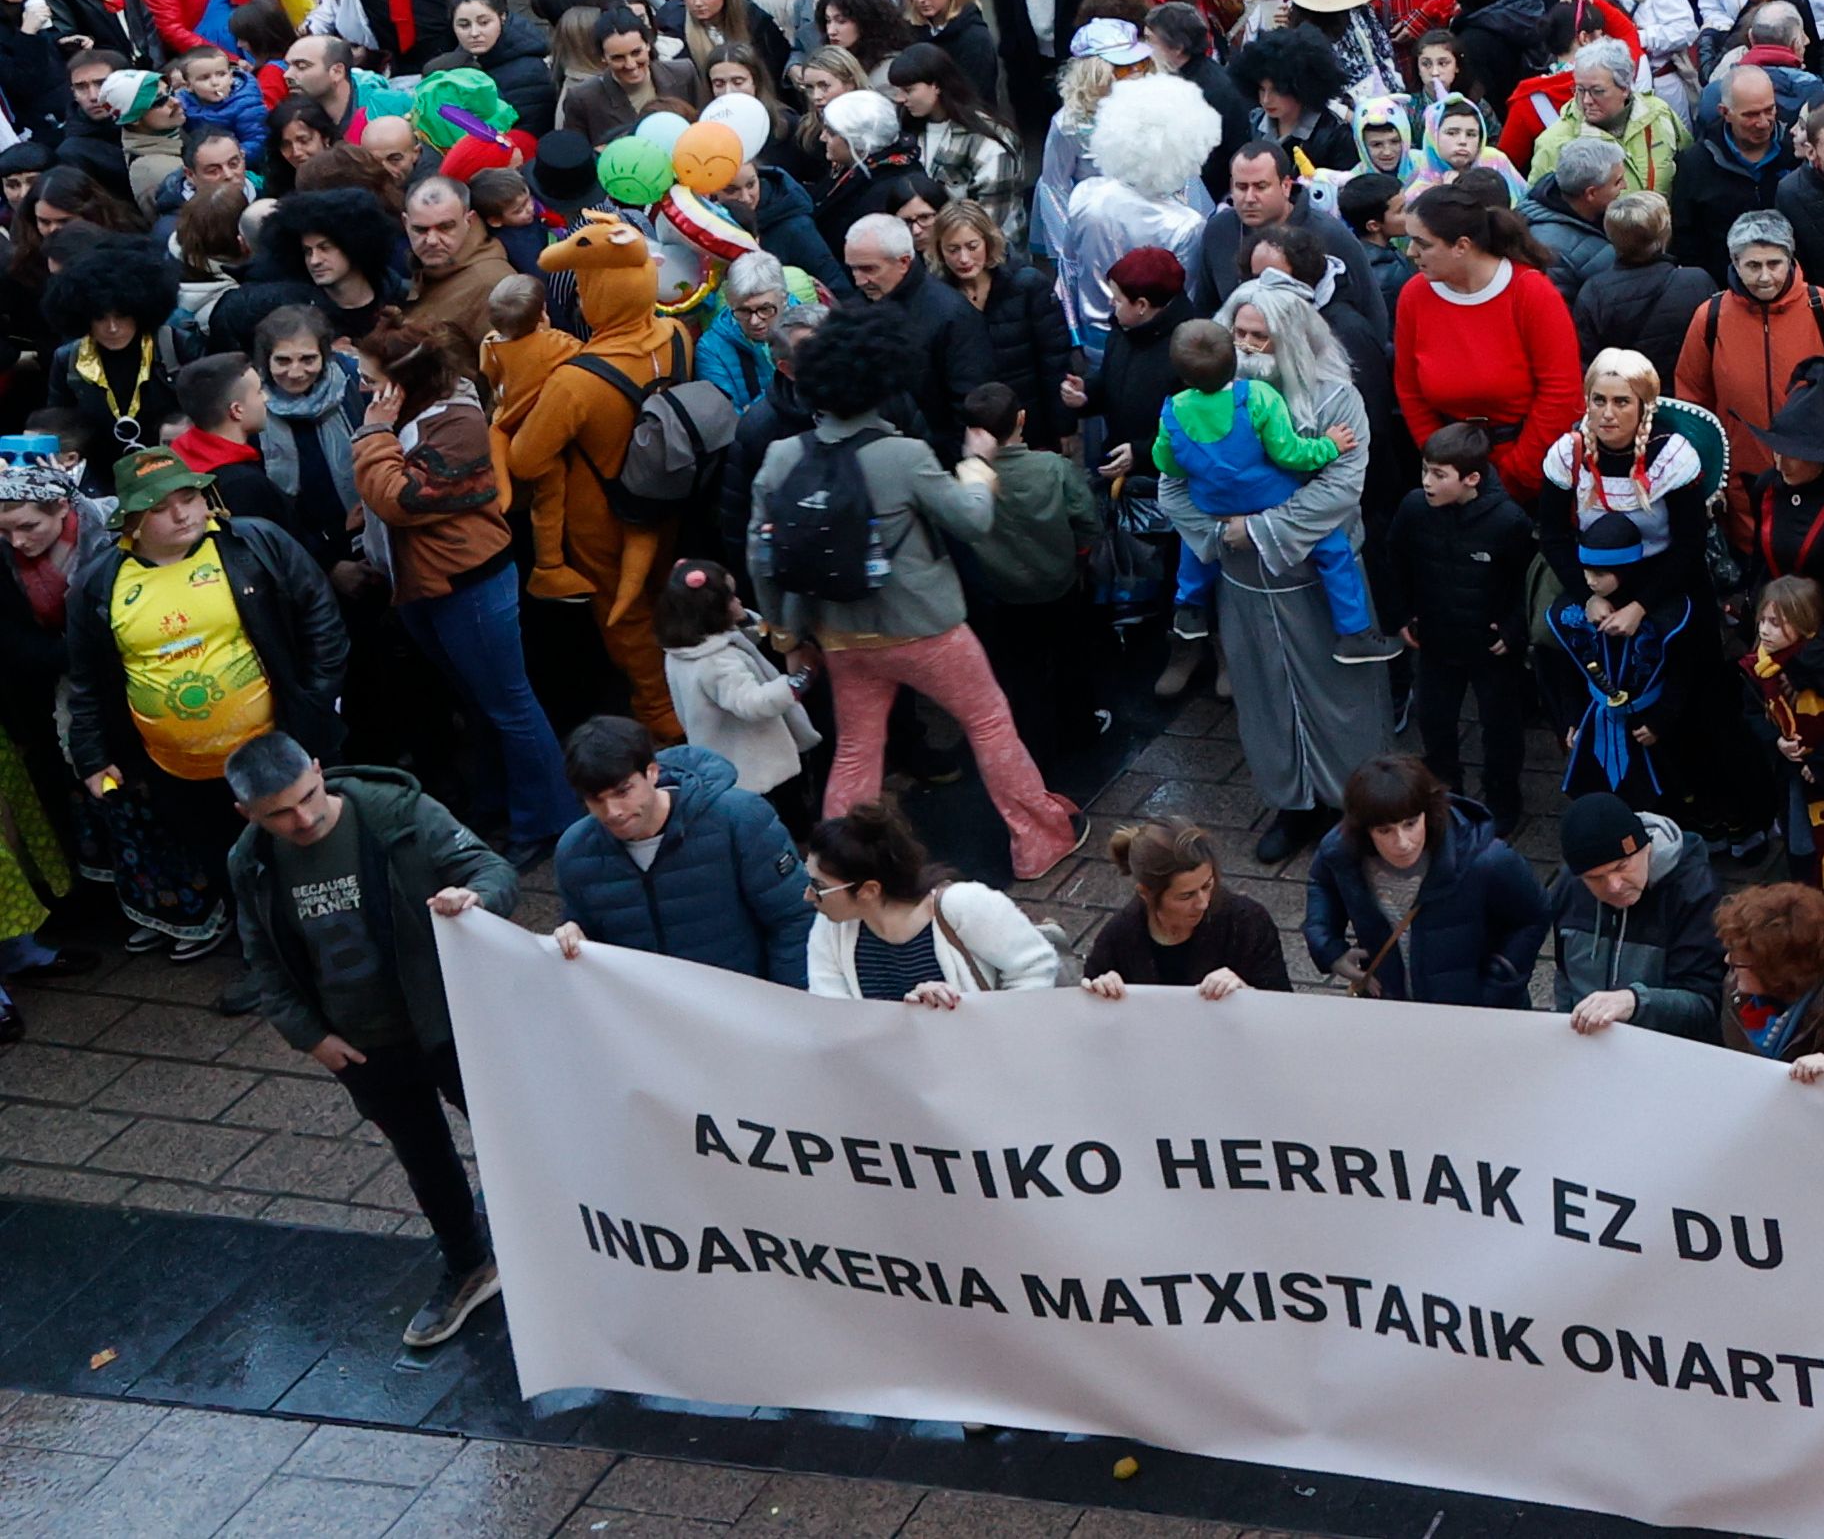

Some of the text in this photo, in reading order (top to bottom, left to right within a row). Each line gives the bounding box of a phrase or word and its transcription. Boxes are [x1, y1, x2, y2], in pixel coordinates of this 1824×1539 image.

[292, 874, 358, 899] BECAUSE
[297, 894, 361, 920] PLANET
[695, 1113, 1784, 1270] AZPEITIKO HERRIAK EZ DU
[579, 1203, 1009, 1314] INDARKERIA
[1020, 1271, 1544, 1366] MATXISTARIK
